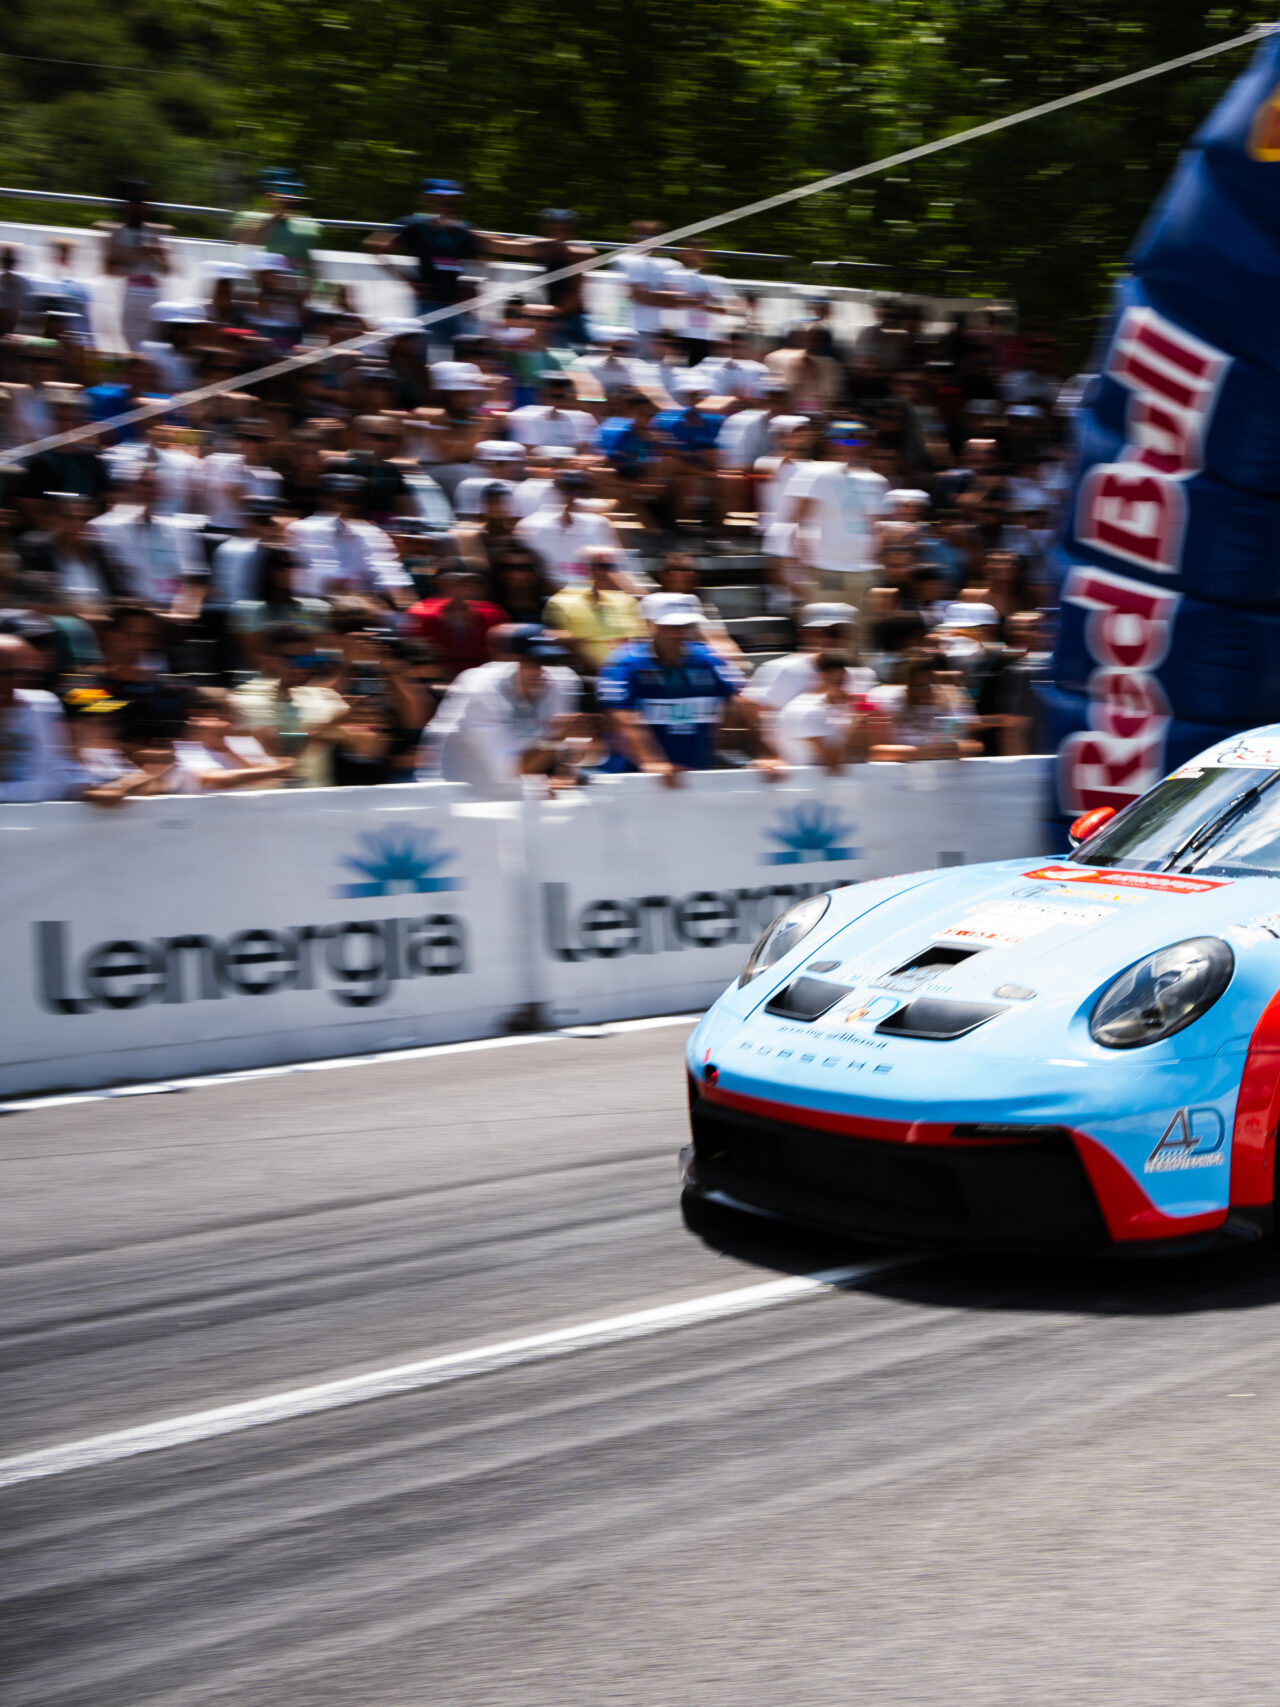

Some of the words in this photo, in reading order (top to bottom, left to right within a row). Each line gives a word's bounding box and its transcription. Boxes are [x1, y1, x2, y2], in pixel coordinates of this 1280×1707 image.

[1074, 305, 1236, 574] Bull
[1056, 565, 1184, 817] Red
[739, 1040, 895, 1075] PORSCHE
[1146, 1106, 1226, 1163] AD
